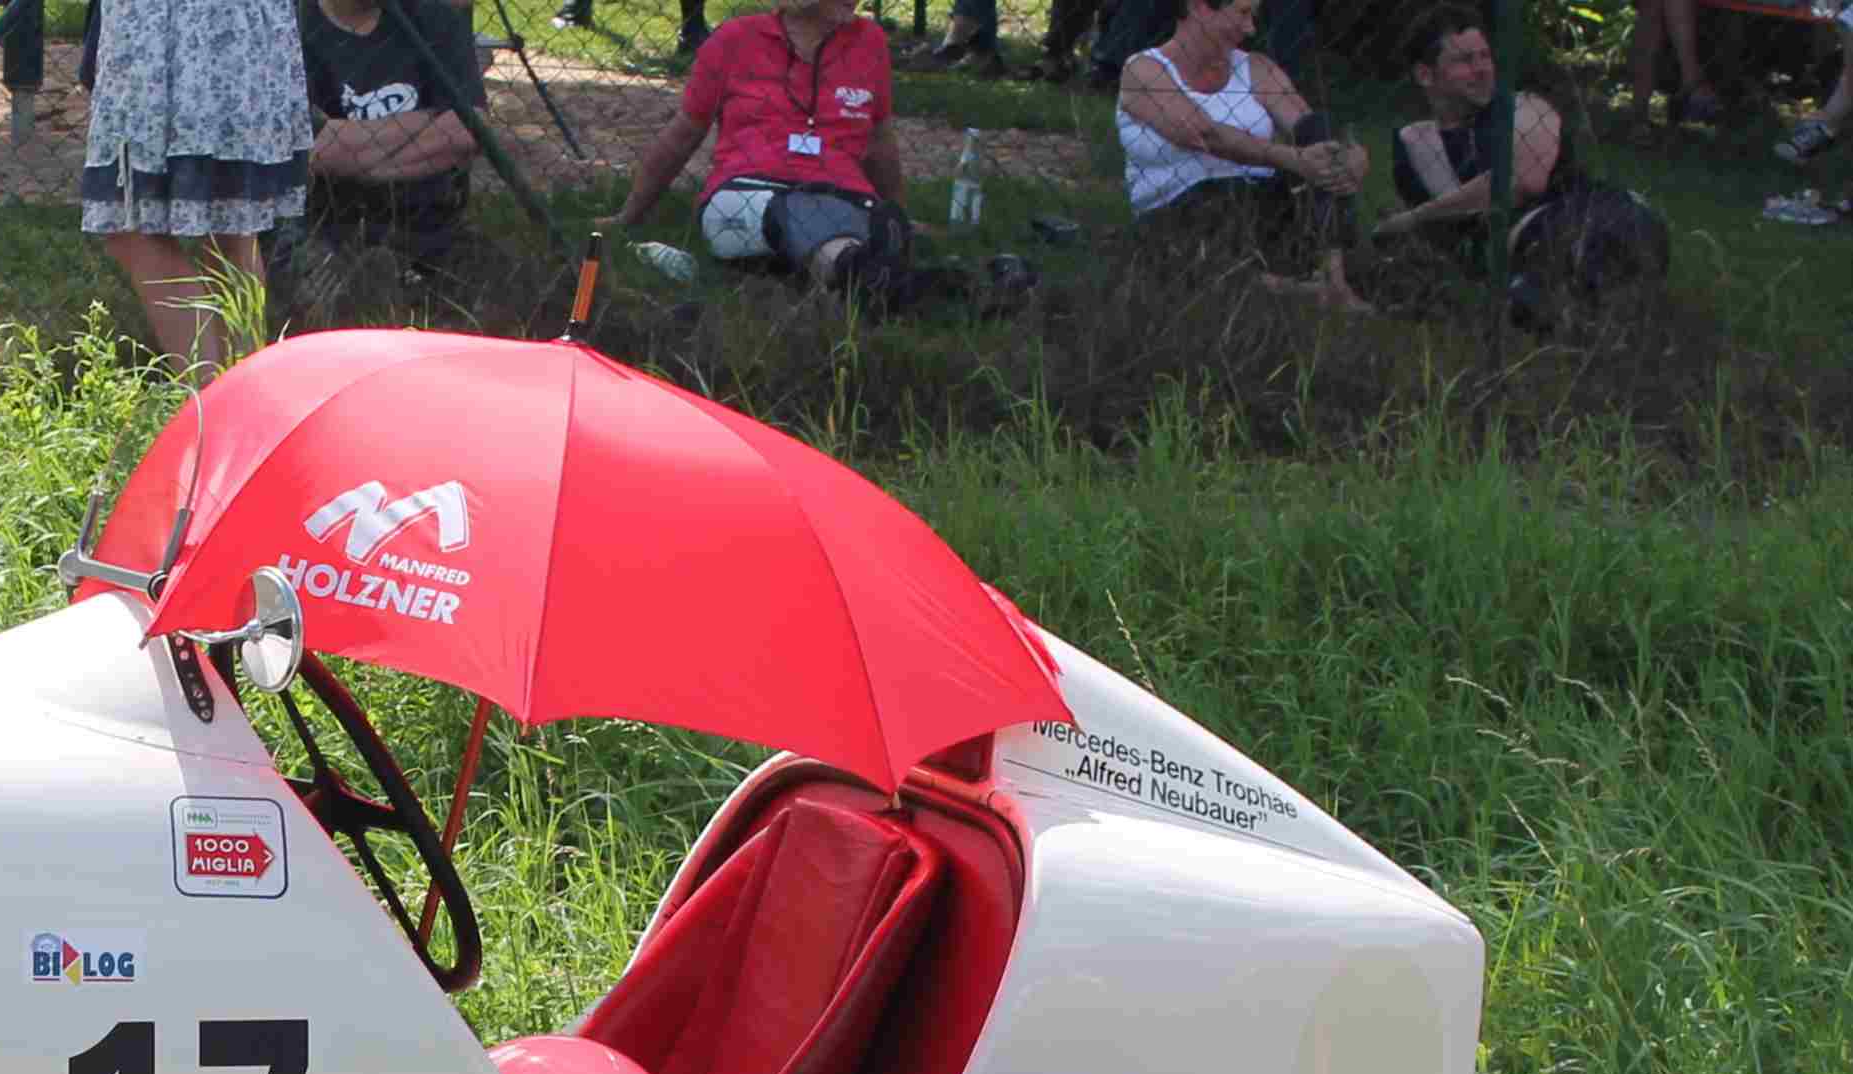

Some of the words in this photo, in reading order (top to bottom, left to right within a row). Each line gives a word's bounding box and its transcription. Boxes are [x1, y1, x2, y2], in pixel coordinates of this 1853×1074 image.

[378, 552, 470, 586] MANFRED
[277, 553, 461, 625] HOLZNER
[1032, 720, 1204, 787] Mercedes-Benz
[194, 838, 250, 853] 1000
[191, 857, 255, 873] MIGLIA
